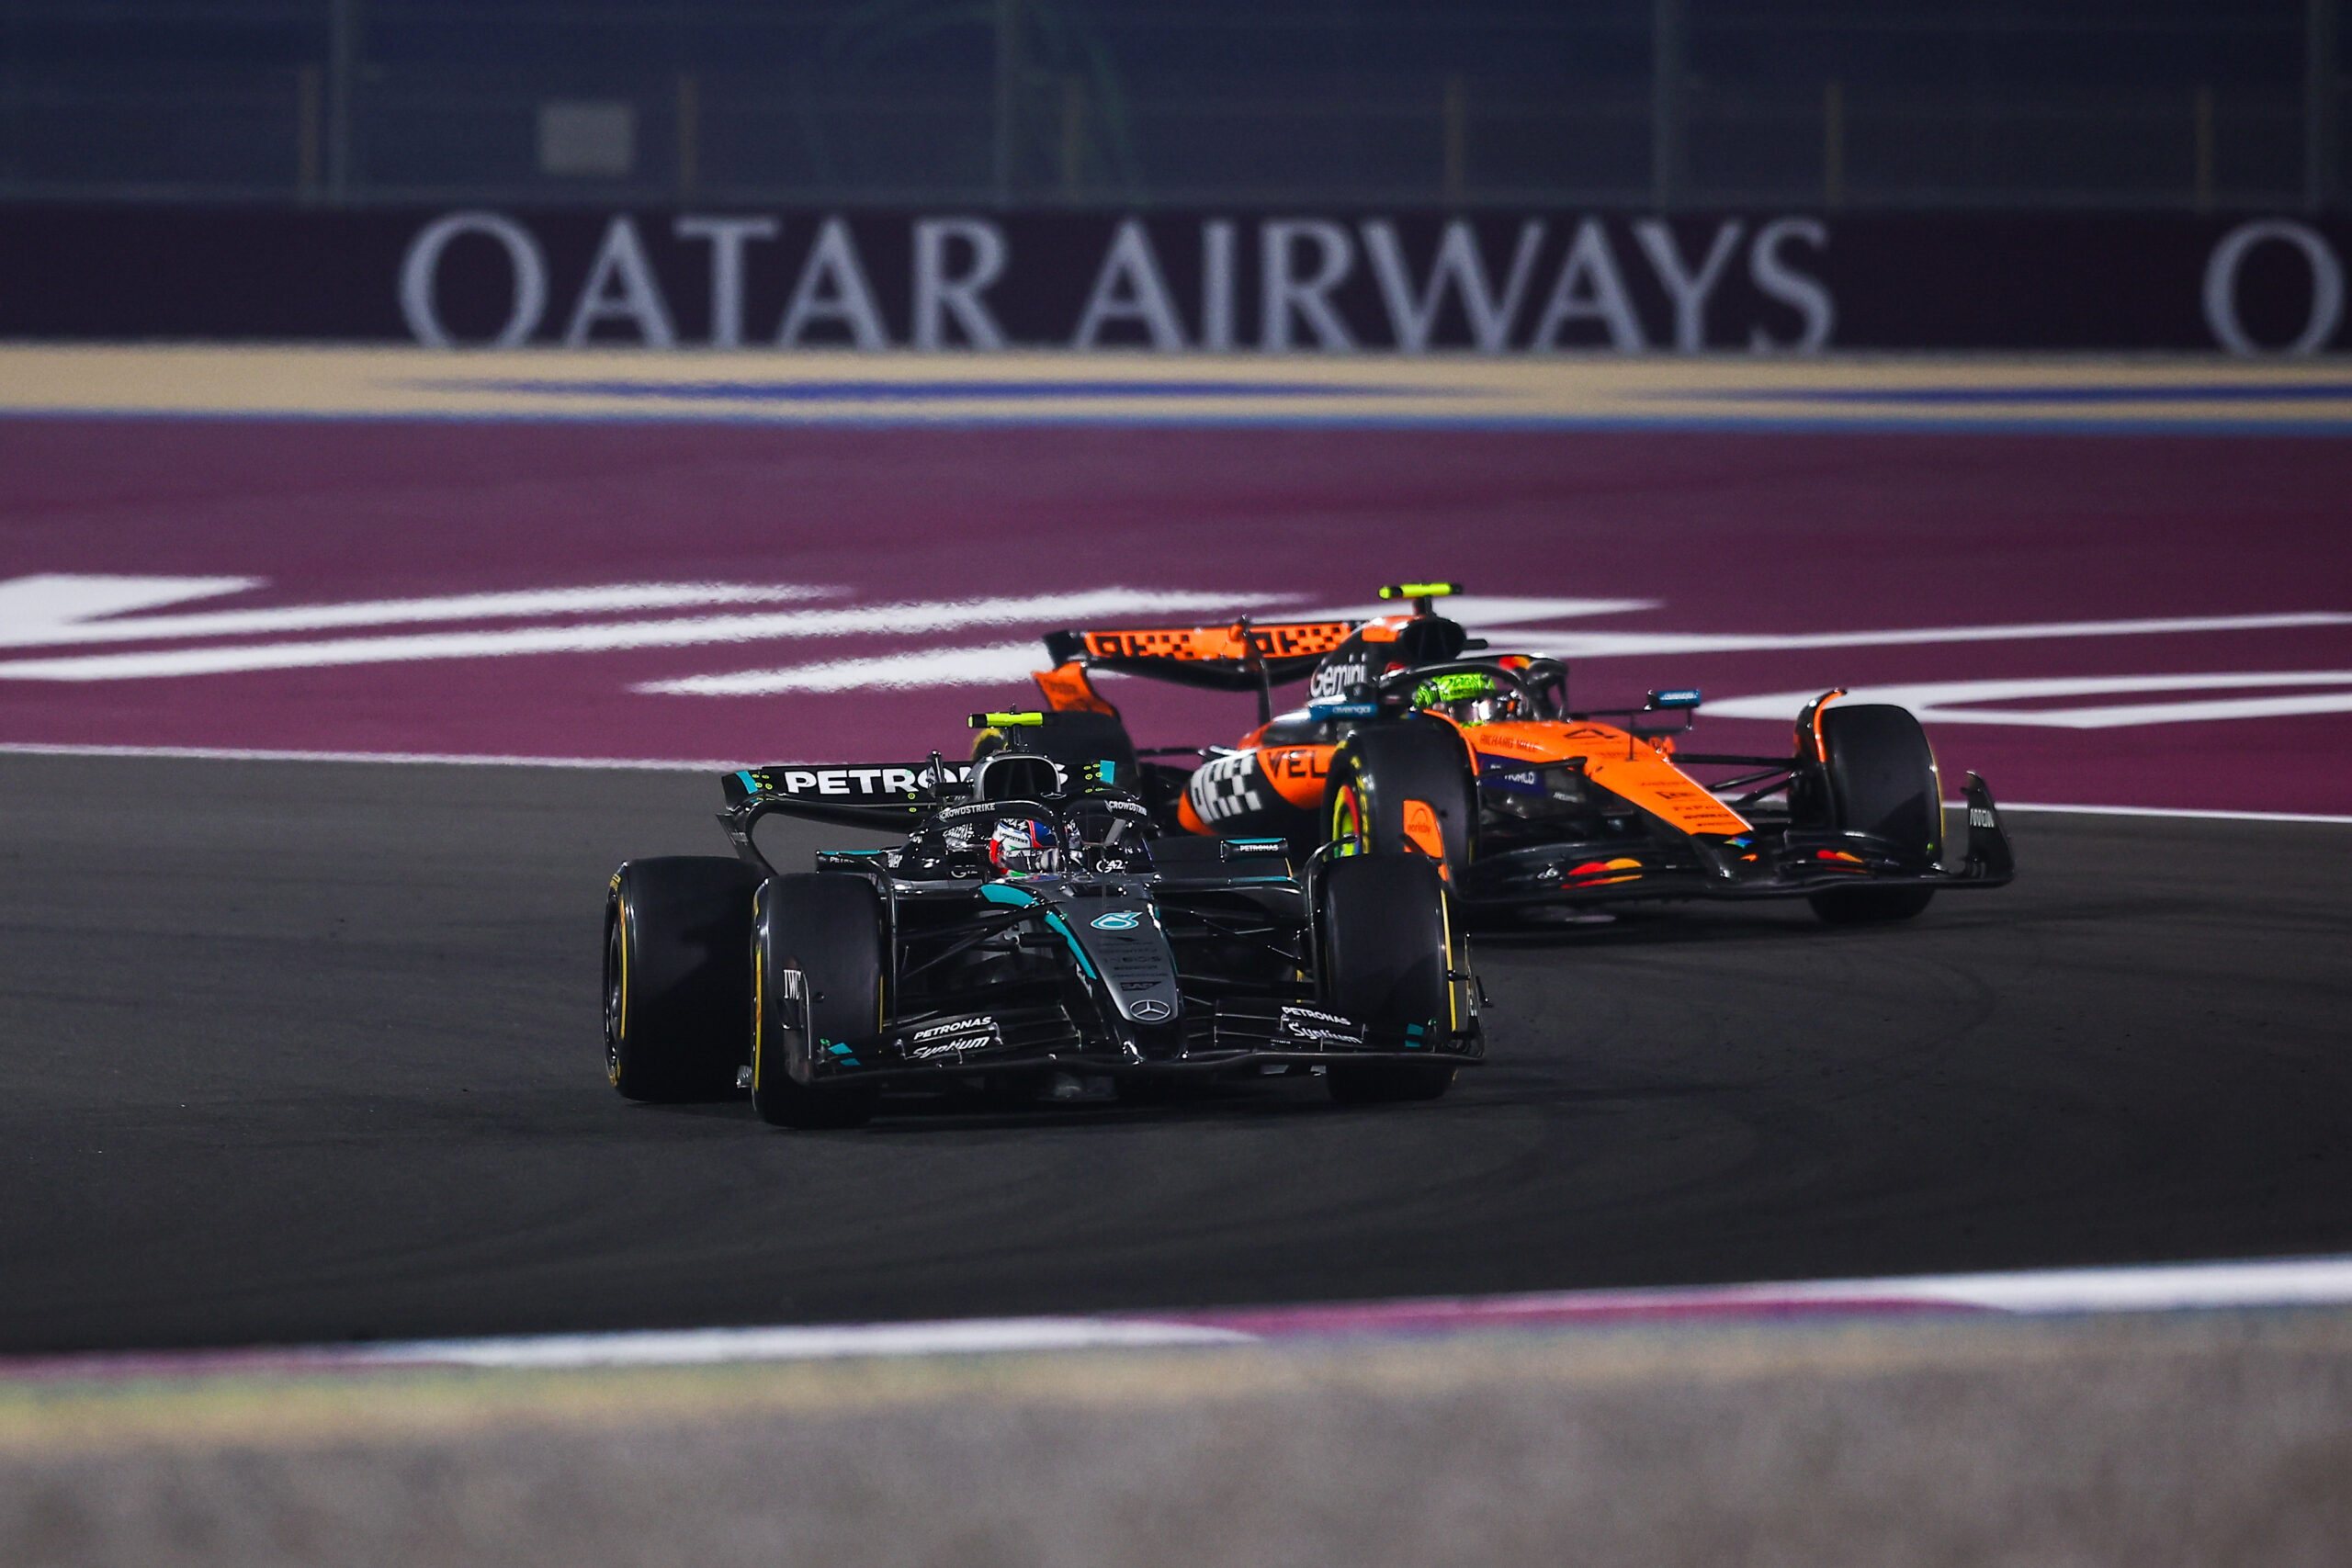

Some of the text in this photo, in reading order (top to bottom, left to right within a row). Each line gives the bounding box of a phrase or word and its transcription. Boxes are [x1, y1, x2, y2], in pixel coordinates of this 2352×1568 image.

[1068, 217, 1835, 355] AIRWAYS
[1310, 653, 1366, 698] Gemini
[1265, 750, 1330, 778] VEL
[784, 765, 1069, 795] PETRO
[940, 802, 997, 821] CROWDSTRIKE
[1239, 843, 1279, 852] PETRONAS
[783, 969, 802, 999] IWC
[913, 1016, 992, 1041] PETRONAS
[1281, 1006, 1351, 1026] PETRONAS
